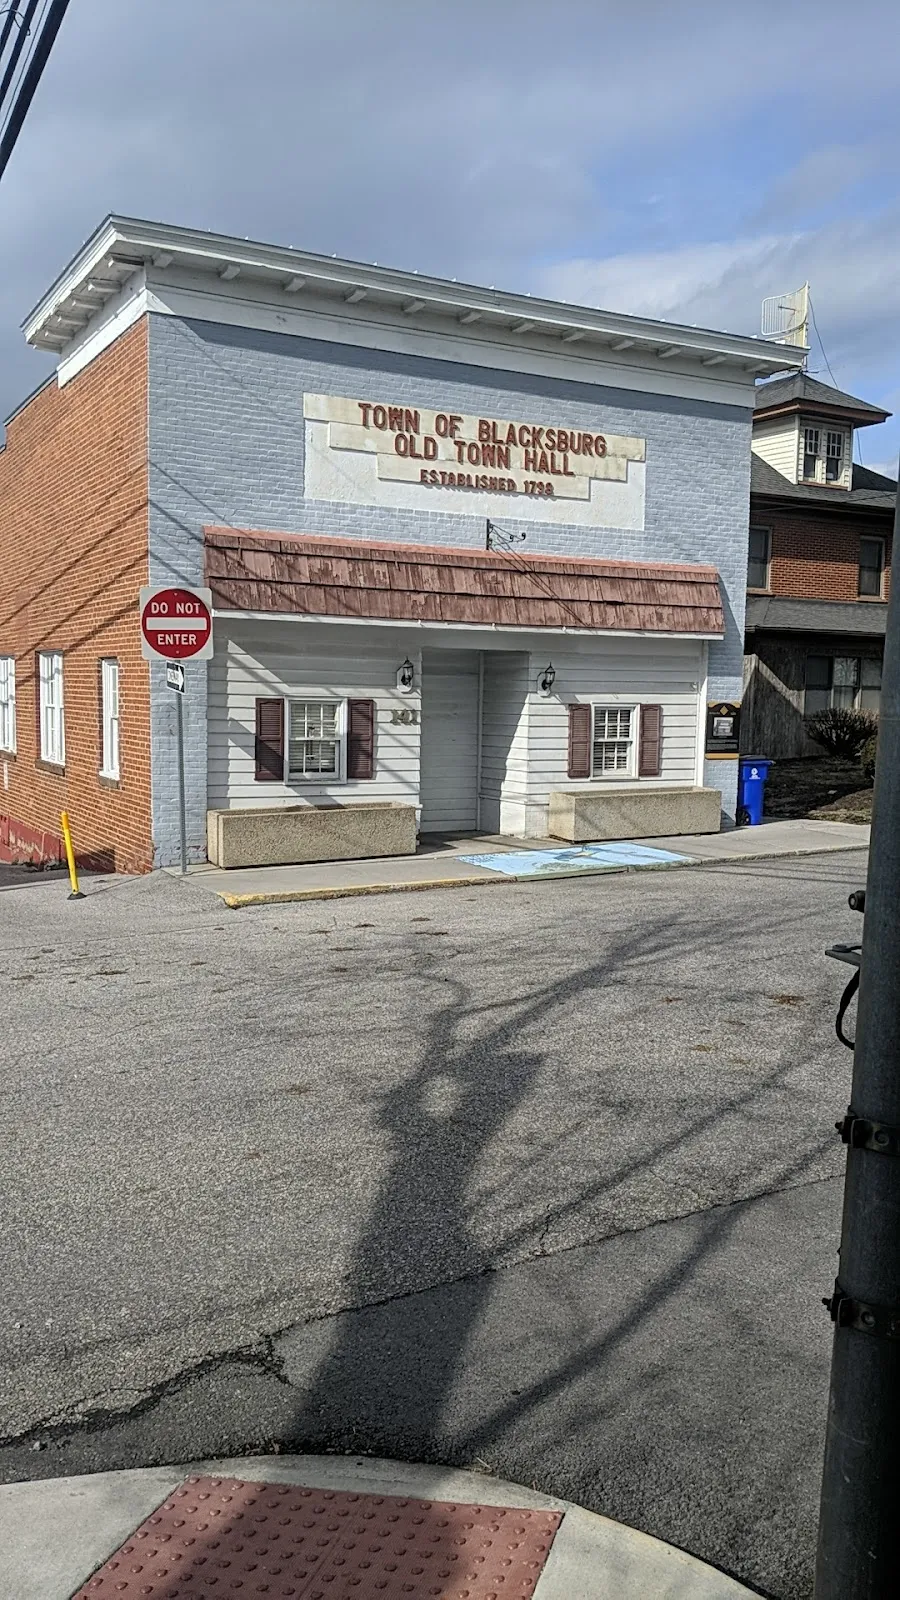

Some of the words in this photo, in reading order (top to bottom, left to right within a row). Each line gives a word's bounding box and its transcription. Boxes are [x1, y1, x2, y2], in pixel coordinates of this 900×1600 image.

[358, 403, 420, 435] TOWN
[435, 414, 464, 440] OF
[478, 420, 607, 458] BLACKSBURG
[395, 434, 438, 460] OLD
[454, 440, 511, 471] TOWN
[524, 450, 576, 477] HALL
[420, 469, 517, 491] ESTABLISHED
[151, 602, 168, 614] DO
[176, 602, 200, 614] NOT
[157, 634, 197, 645] ENTER
